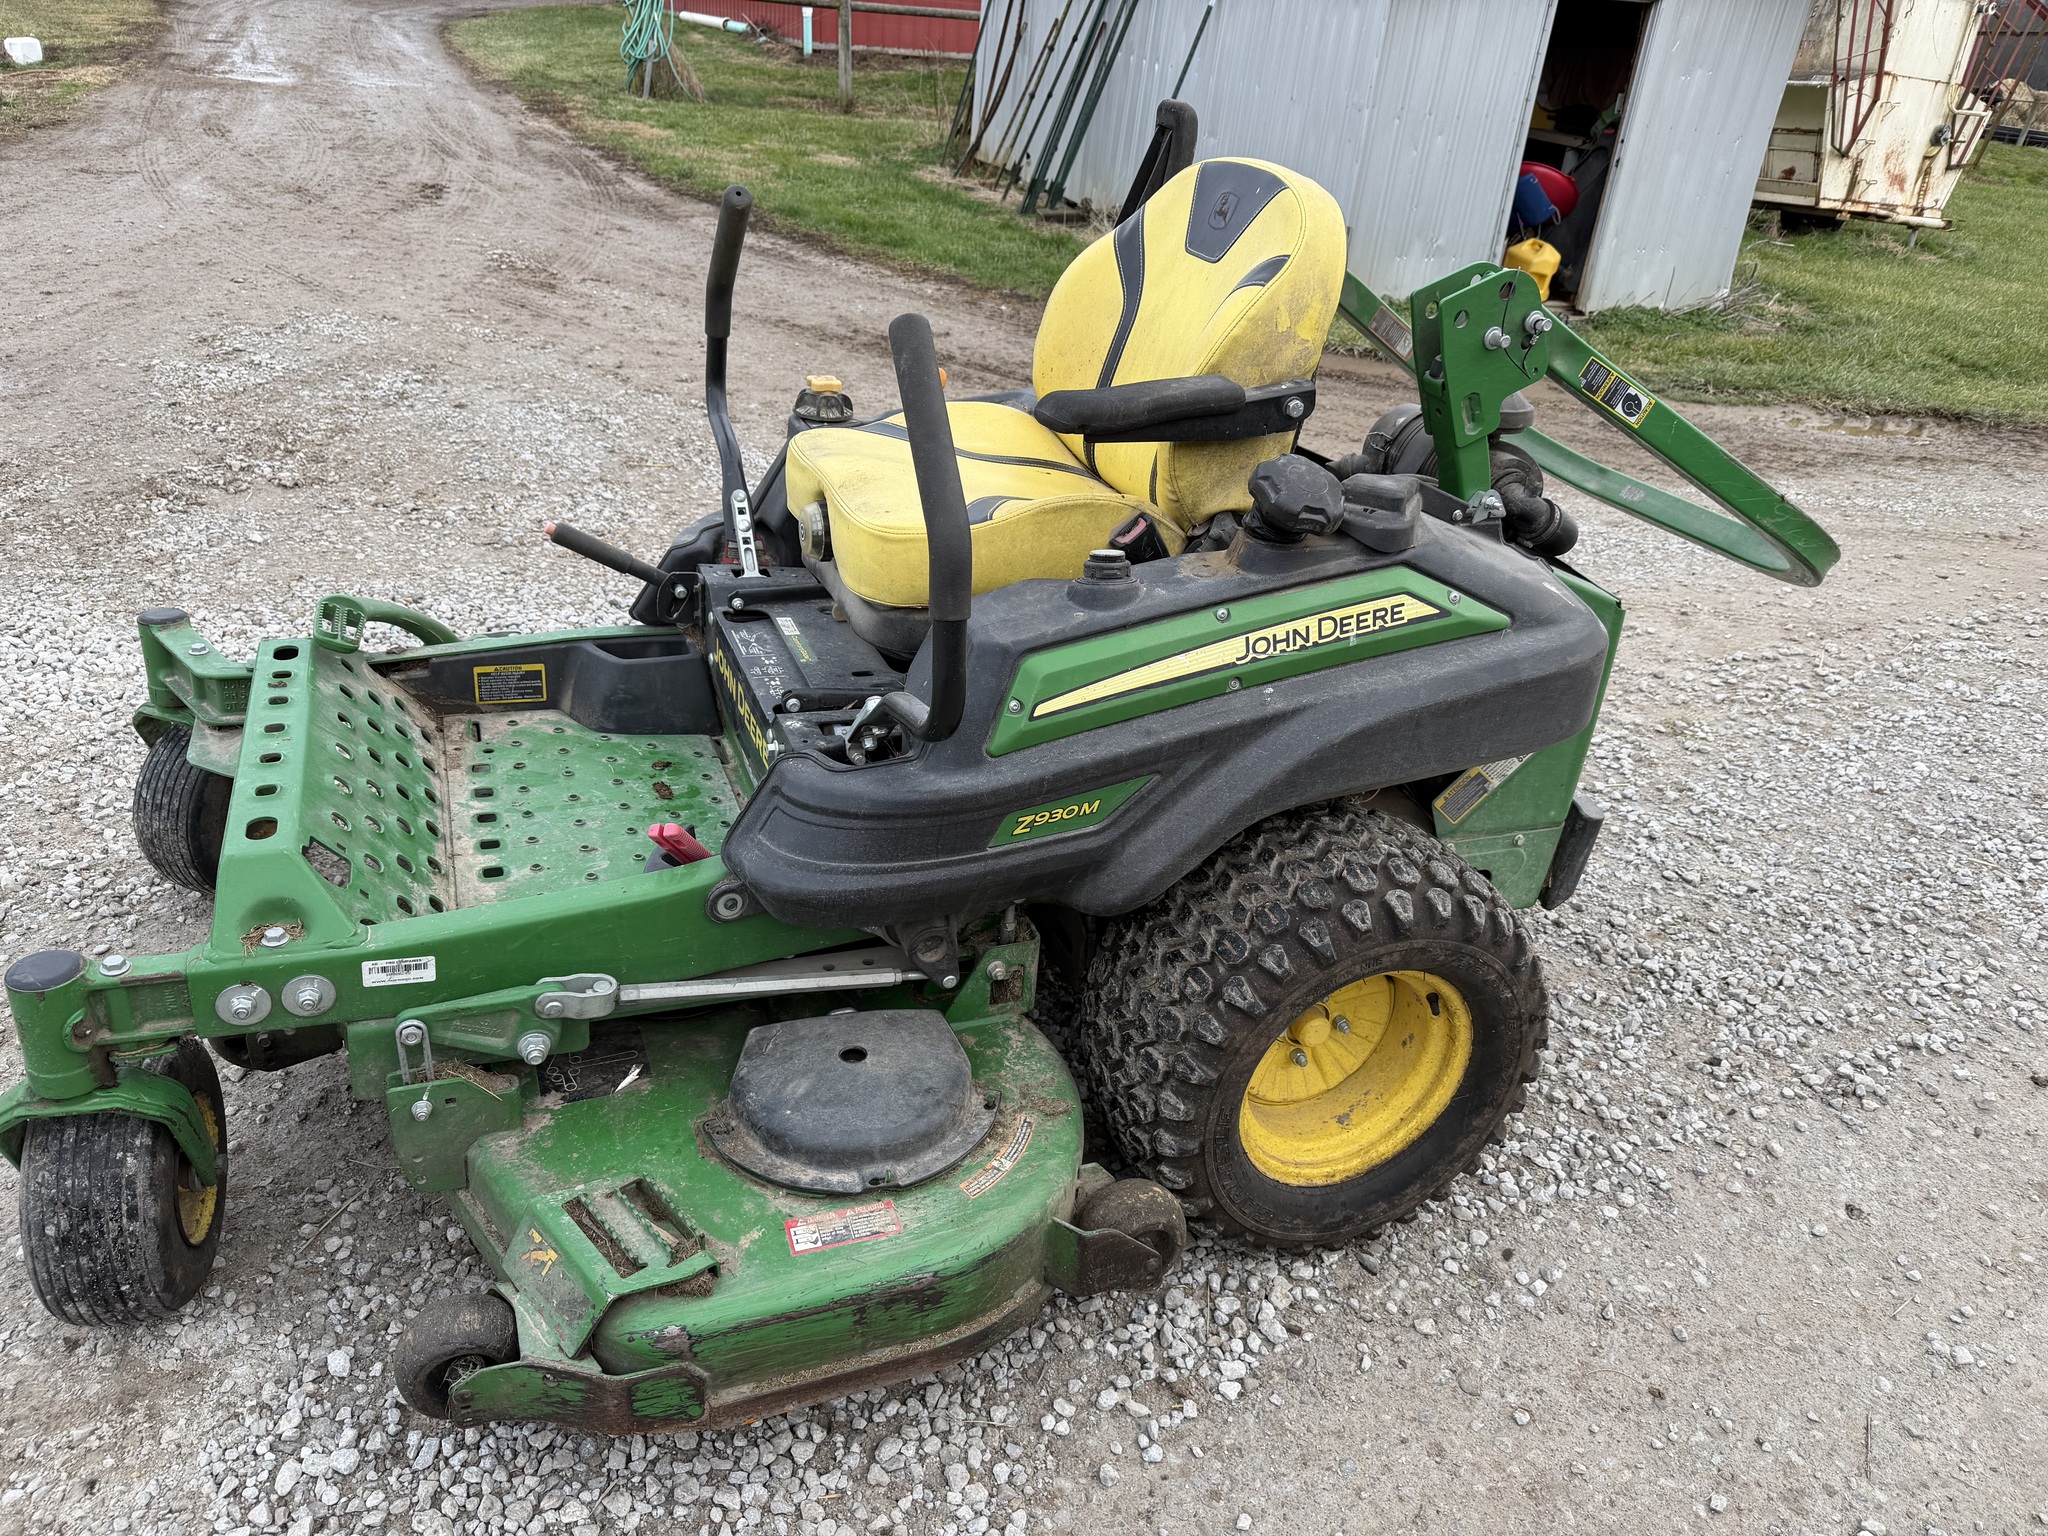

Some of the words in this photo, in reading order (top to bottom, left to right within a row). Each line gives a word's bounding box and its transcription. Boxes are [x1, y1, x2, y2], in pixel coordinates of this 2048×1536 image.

[1235, 626, 1310, 663] JOHN
[1317, 602, 1405, 641] DEERE
[714, 638, 737, 701] JOHN
[737, 679, 769, 770] DEERE
[1012, 799, 1101, 836] Z930M
[1214, 1106, 1274, 1224] CARLISLE
